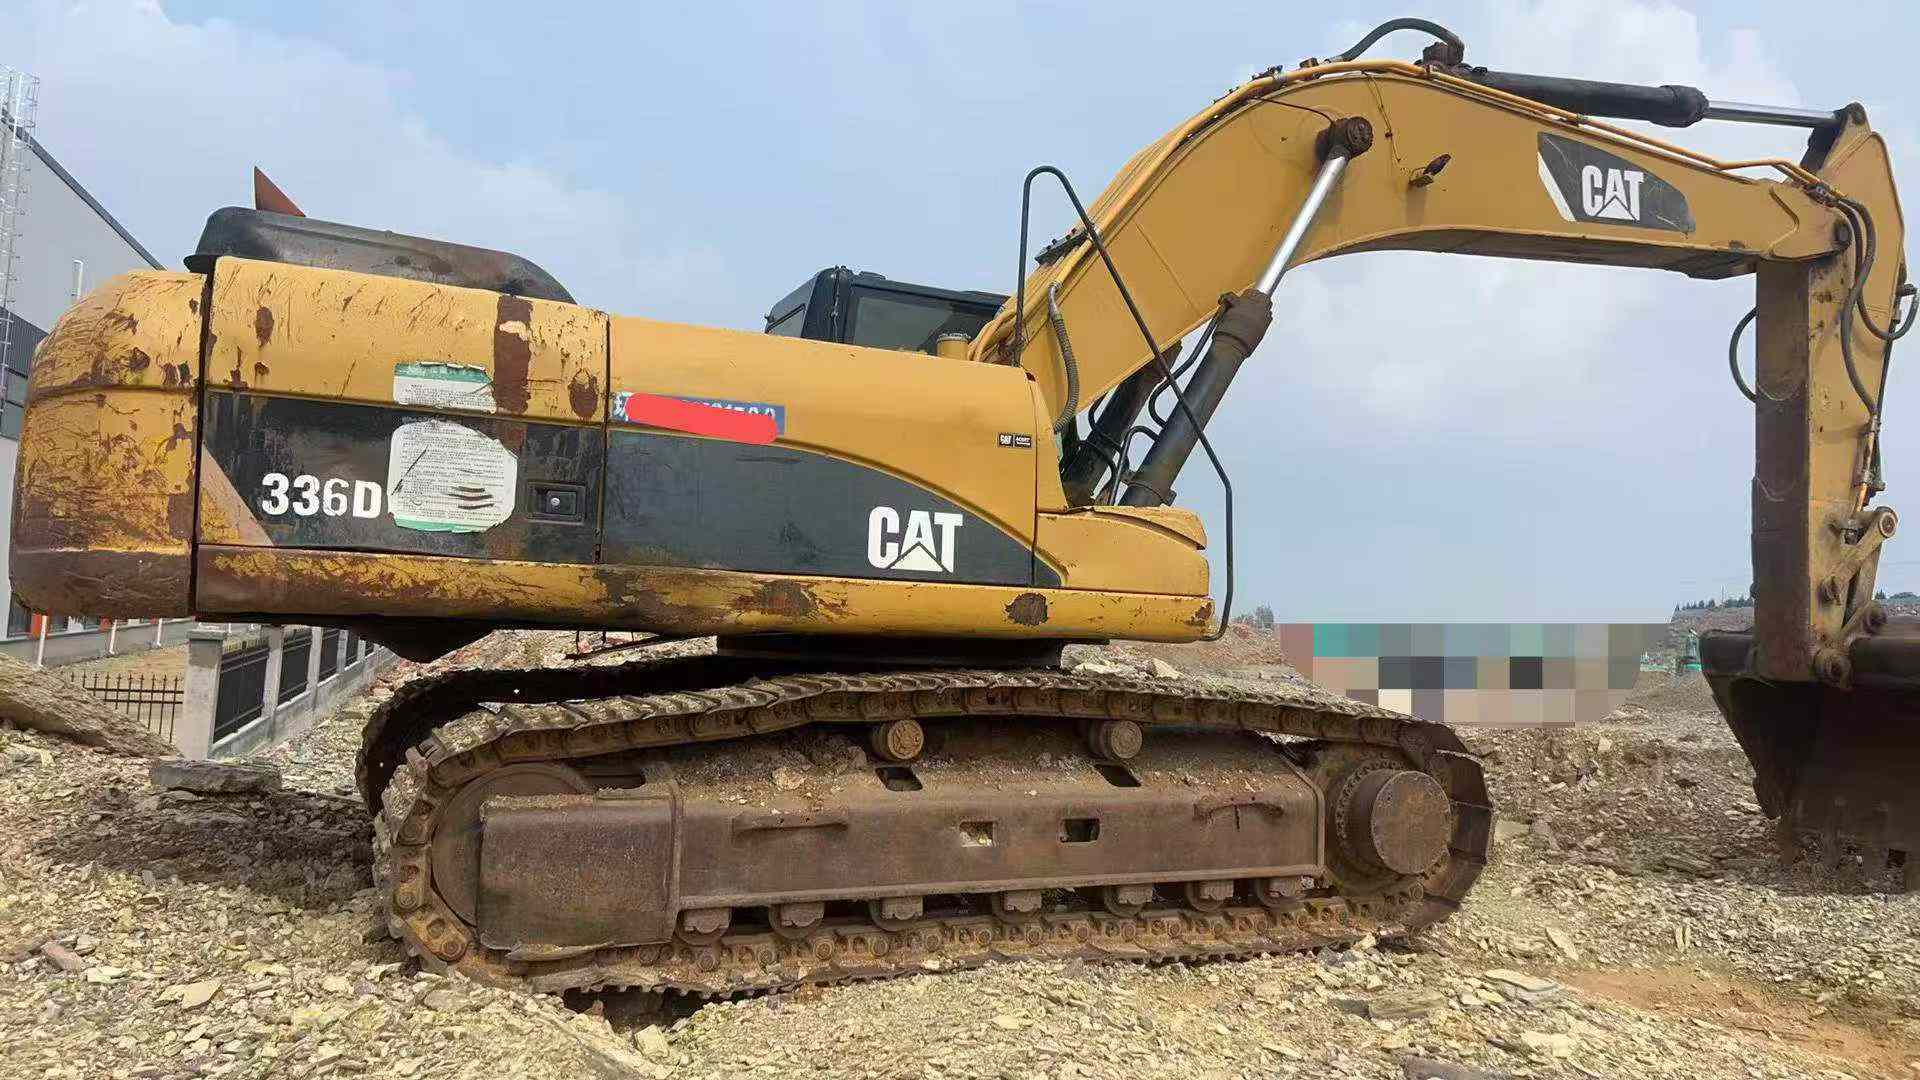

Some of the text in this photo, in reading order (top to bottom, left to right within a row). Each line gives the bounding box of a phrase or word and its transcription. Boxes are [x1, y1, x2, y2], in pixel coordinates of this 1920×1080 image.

[1582, 165, 1644, 221] CAT
[262, 473, 382, 518] 336D
[868, 506, 963, 573] CAT
